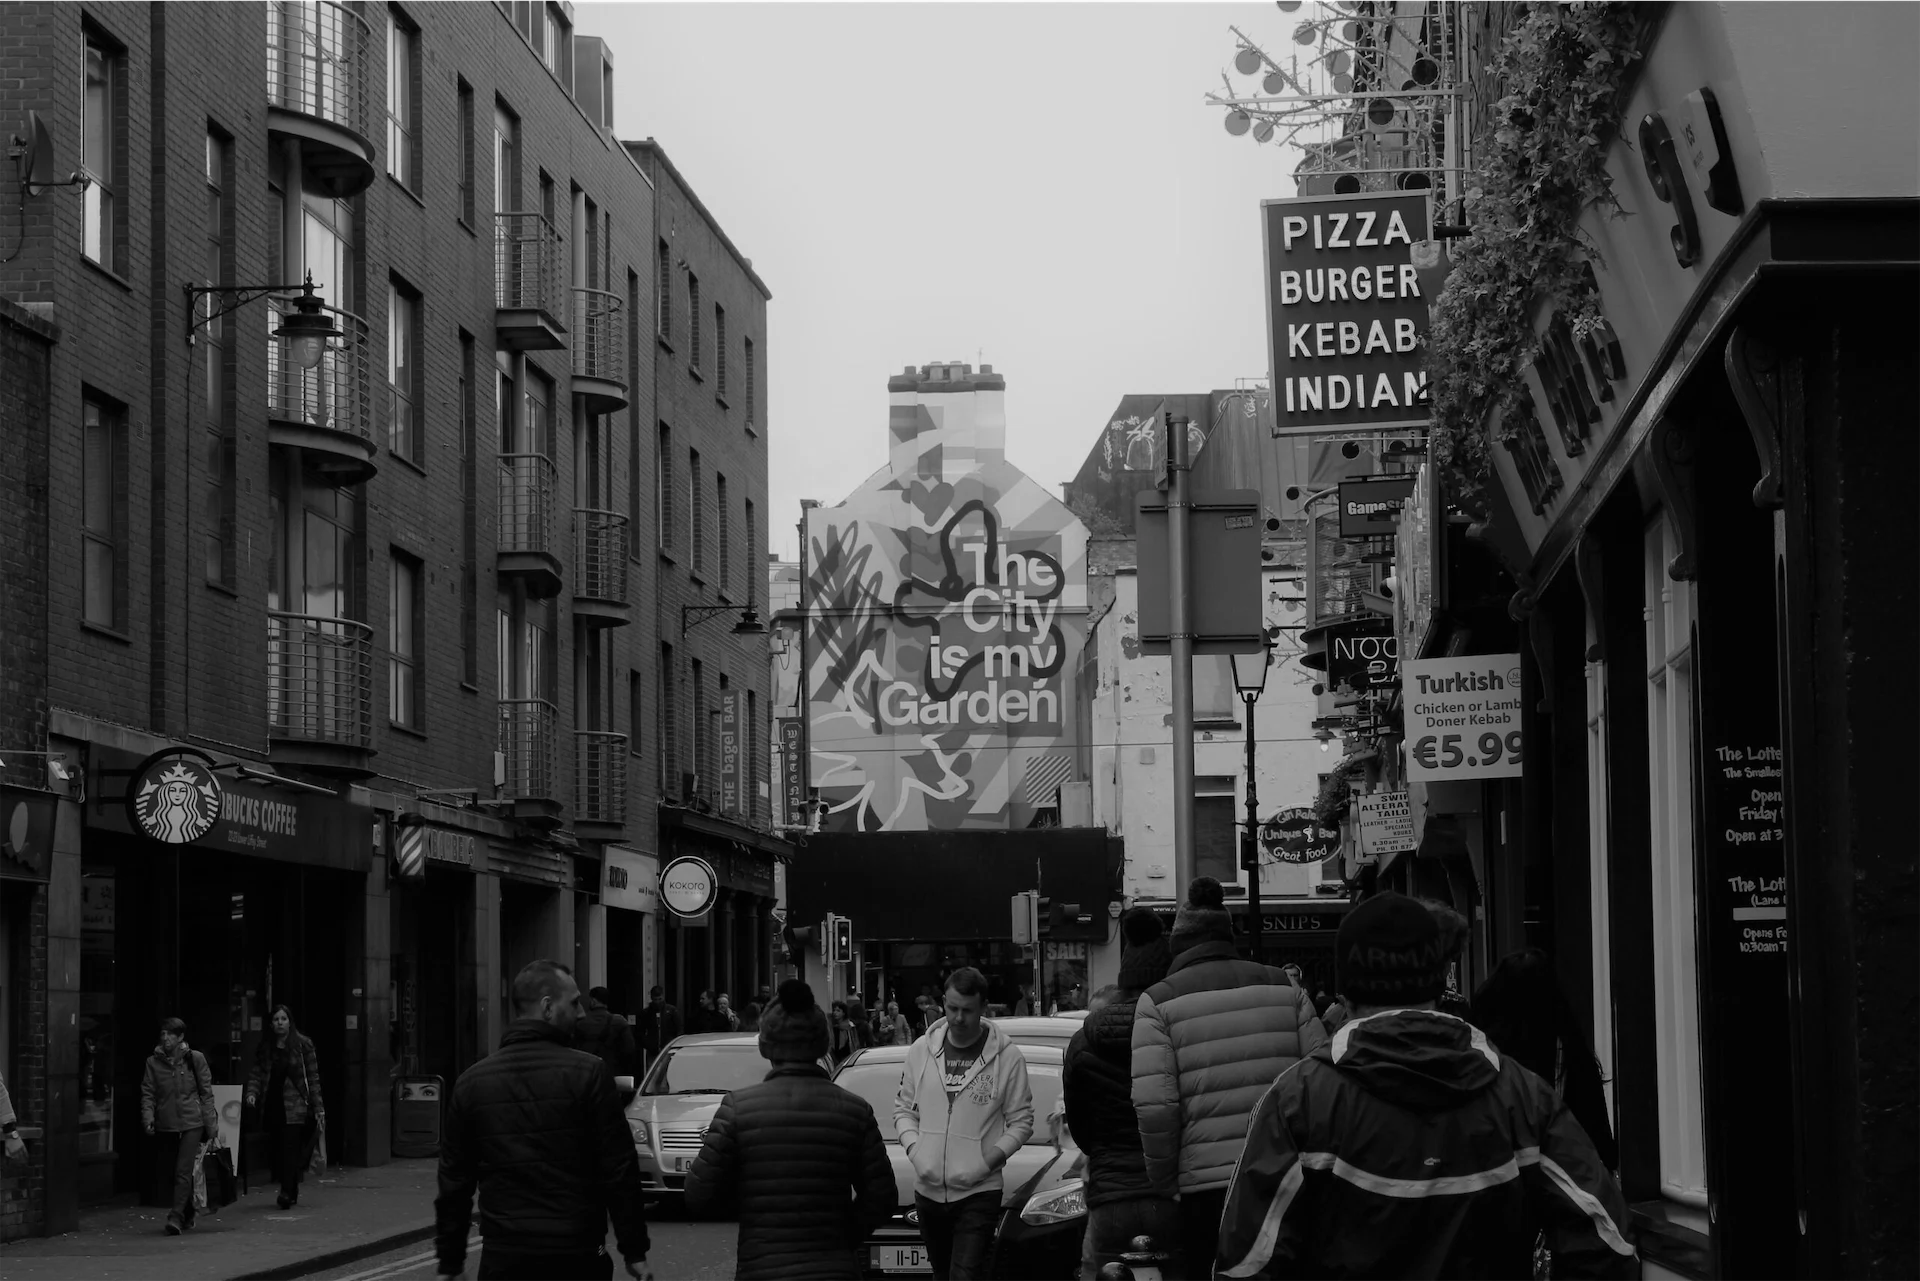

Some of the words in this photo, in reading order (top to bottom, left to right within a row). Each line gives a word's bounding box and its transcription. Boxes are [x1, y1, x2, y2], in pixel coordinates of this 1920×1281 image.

[1283, 210, 1412, 250] PIZZA
[1280, 263, 1421, 305] BURGER
[1288, 318, 1417, 358] KEBAB
[1285, 371, 1429, 412] INDIAN
[963, 543, 1058, 586] The
[963, 587, 1058, 644] City
[930, 636, 969, 679] is
[984, 645, 1058, 689] my
[1415, 670, 1504, 694] Turkish
[724, 695, 734, 723] BAR
[879, 680, 1057, 726] Garden
[1414, 702, 1465, 715] Chicken
[1468, 702, 1482, 712] or
[1486, 698, 1521, 711] Lamb
[1426, 716, 1466, 727] Doner
[1469, 712, 1511, 725] Kebab
[722, 731, 738, 774] bagel
[1412, 730, 1522, 769] €5.99
[1715, 745, 1744, 762] The
[1722, 766, 1743, 778] The
[724, 781, 735, 810] THE
[1751, 788, 1782, 806] Open
[261, 800, 297, 836] COFFEE
[1738, 805, 1778, 824] Friday
[1264, 829, 1302, 841] Unique
[1318, 828, 1338, 839] Bar
[1725, 828, 1757, 846] Open
[1760, 828, 1772, 842] at
[1273, 846, 1301, 861] Great
[1305, 844, 1328, 861] food
[1727, 876, 1757, 892] The
[1262, 915, 1321, 930] SNIPS
[1743, 927, 1773, 942] Opens
[1046, 941, 1086, 960] SALE
